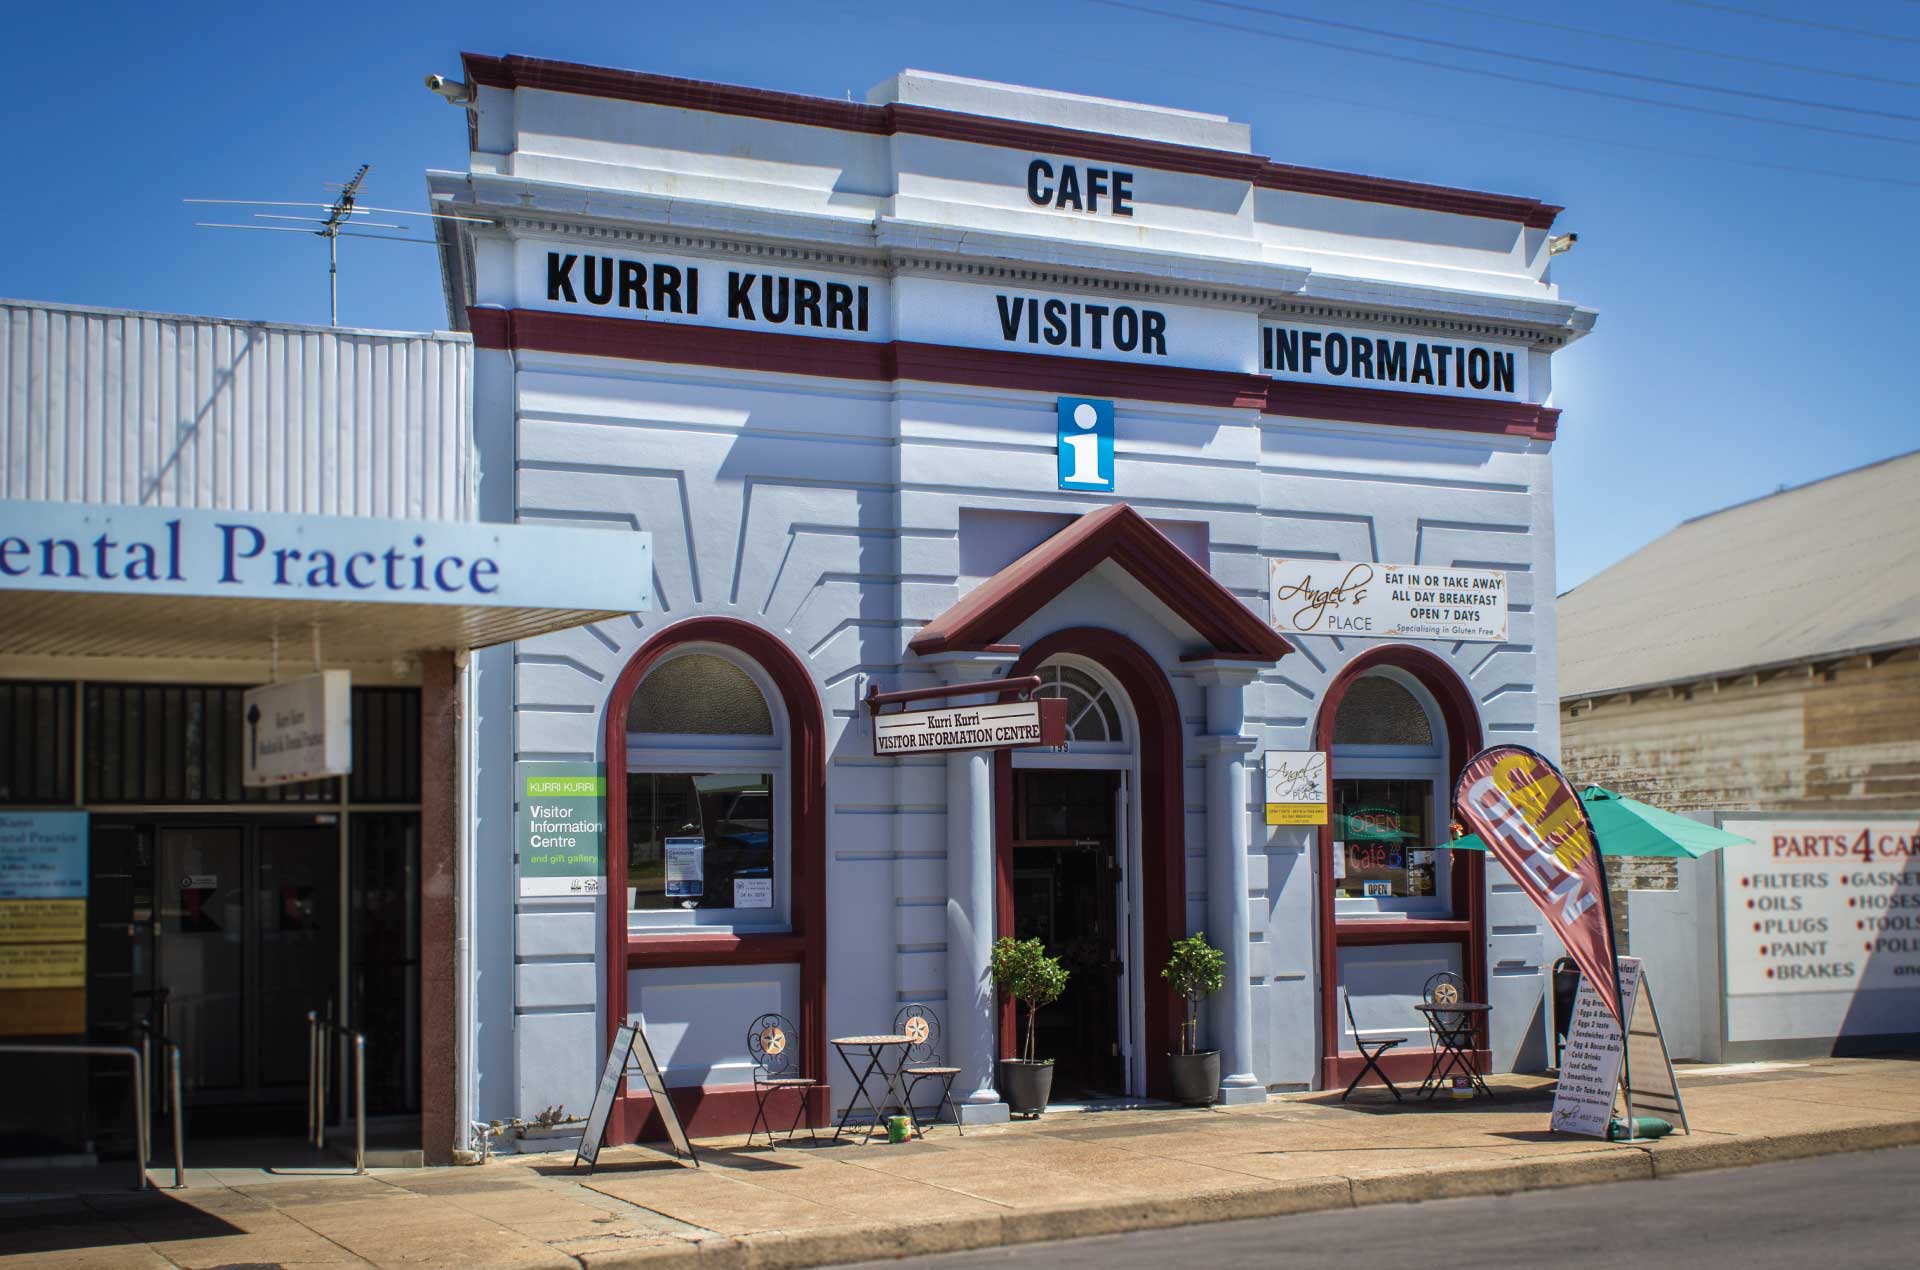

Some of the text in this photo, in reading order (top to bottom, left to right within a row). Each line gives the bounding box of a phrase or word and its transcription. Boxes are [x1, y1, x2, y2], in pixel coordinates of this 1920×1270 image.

[1028, 159, 1133, 216] CAFE
[548, 252, 868, 331] KURRI KURRI
[996, 295, 1167, 355] VISITOR
[1263, 327, 1514, 393] INFORMATION
[214, 524, 499, 593] Practice
[1385, 573, 1502, 590] EAT IN OR TAKE AWAY
[1278, 563, 1373, 631] Angel's
[1392, 590, 1497, 606] ALL DAY BREAKFAST
[1328, 615, 1372, 630] PLACE
[1410, 608, 1480, 621] OPEN 7 DAYS
[1396, 624, 1440, 634] Specialising
[1442, 625, 1450, 633] in
[1452, 626, 1476, 634] Gluten
[927, 712, 980, 729] Kurri Kurri
[878, 725, 1040, 749] VISITOR INFORMATION CENTRE
[530, 783, 595, 792] KURRI KURRI
[1292, 791, 1321, 801] PLACE
[530, 805, 574, 818] Visitor
[530, 820, 603, 833] Information
[1351, 814, 1399, 833] OPEN
[530, 835, 576, 848] Centre
[1772, 835, 1847, 858] PARTS
[1851, 827, 1875, 863] 4
[1468, 776, 1598, 926] OPEN
[530, 854, 598, 865] and gift gallery
[1752, 873, 1829, 888] FILTERS
[1368, 884, 1388, 896] OPEN
[1757, 894, 1920, 911] OILS HOSES
[1764, 917, 1829, 933] PLUGS
[1771, 941, 1828, 957] PAINT
[1776, 962, 1855, 980] BRAKES
[1579, 1008, 1592, 1018] Eggs
[1577, 1019, 1590, 1029] Eggs
[1571, 1051, 1602, 1061] Cold Drinks
[1581, 1063, 1598, 1071] Coffee
